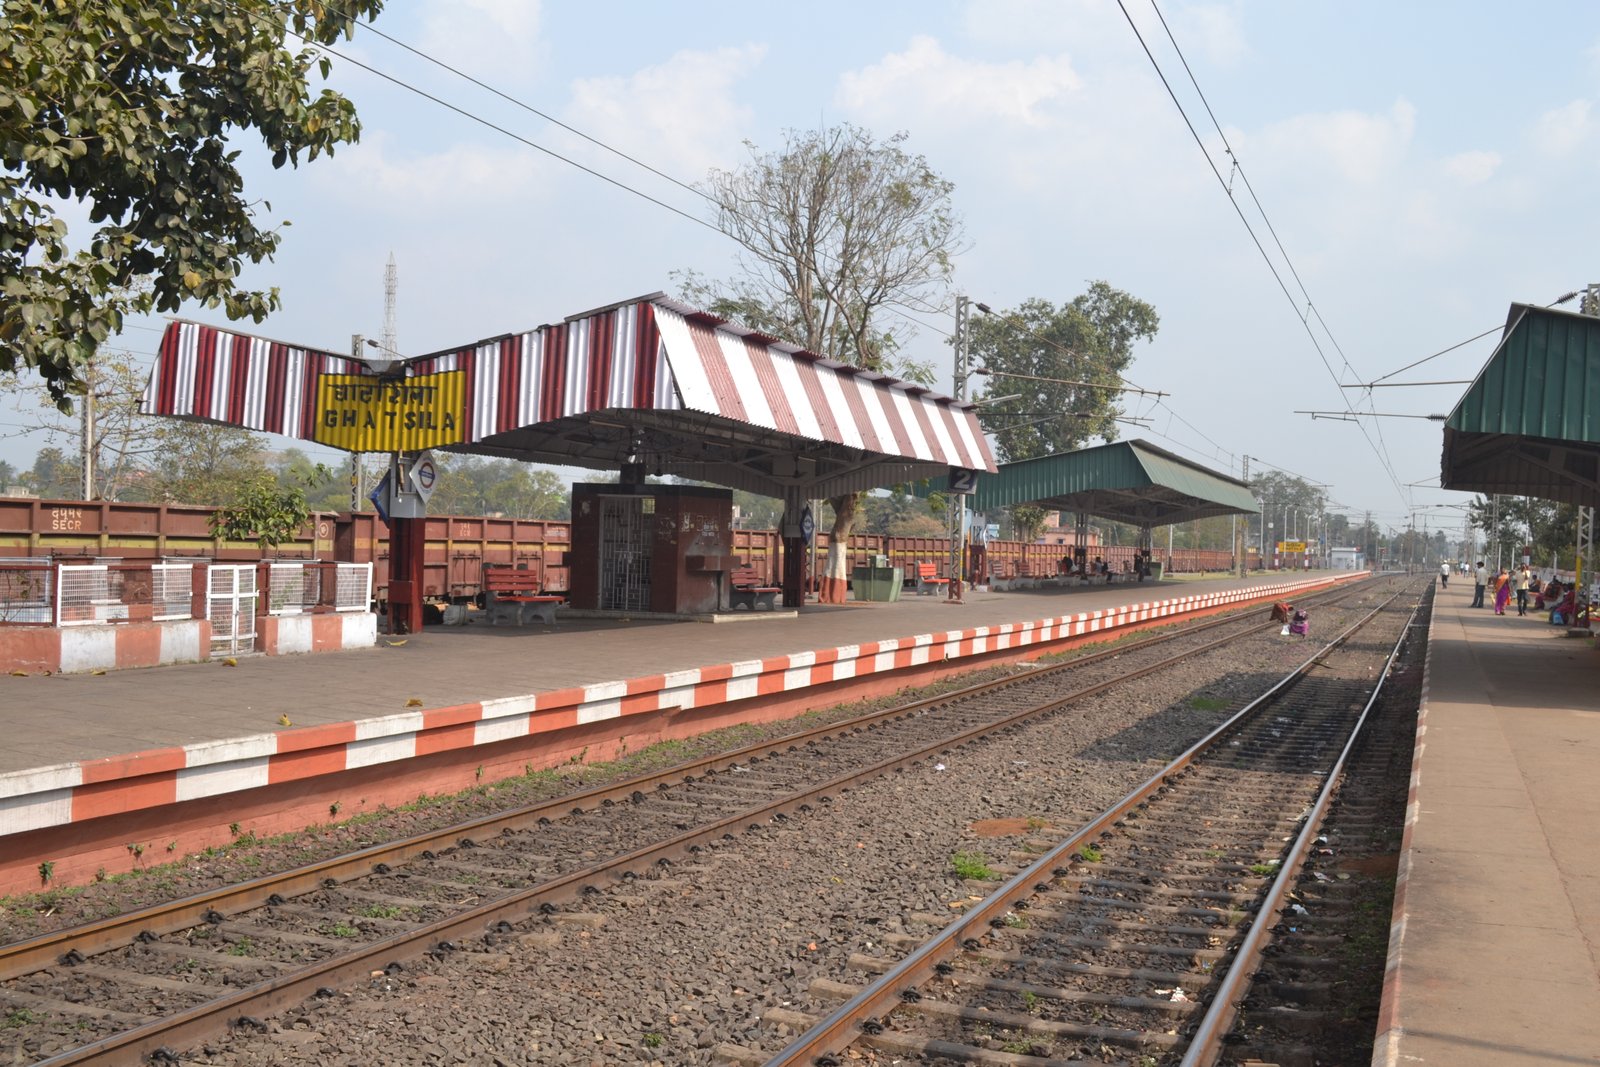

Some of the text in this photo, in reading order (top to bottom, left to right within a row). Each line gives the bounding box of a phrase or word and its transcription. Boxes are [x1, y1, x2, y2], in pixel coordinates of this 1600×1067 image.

[324, 409, 455, 431] GHATSILA
[954, 470, 971, 489] 2
[52, 519, 82, 530] SECR
